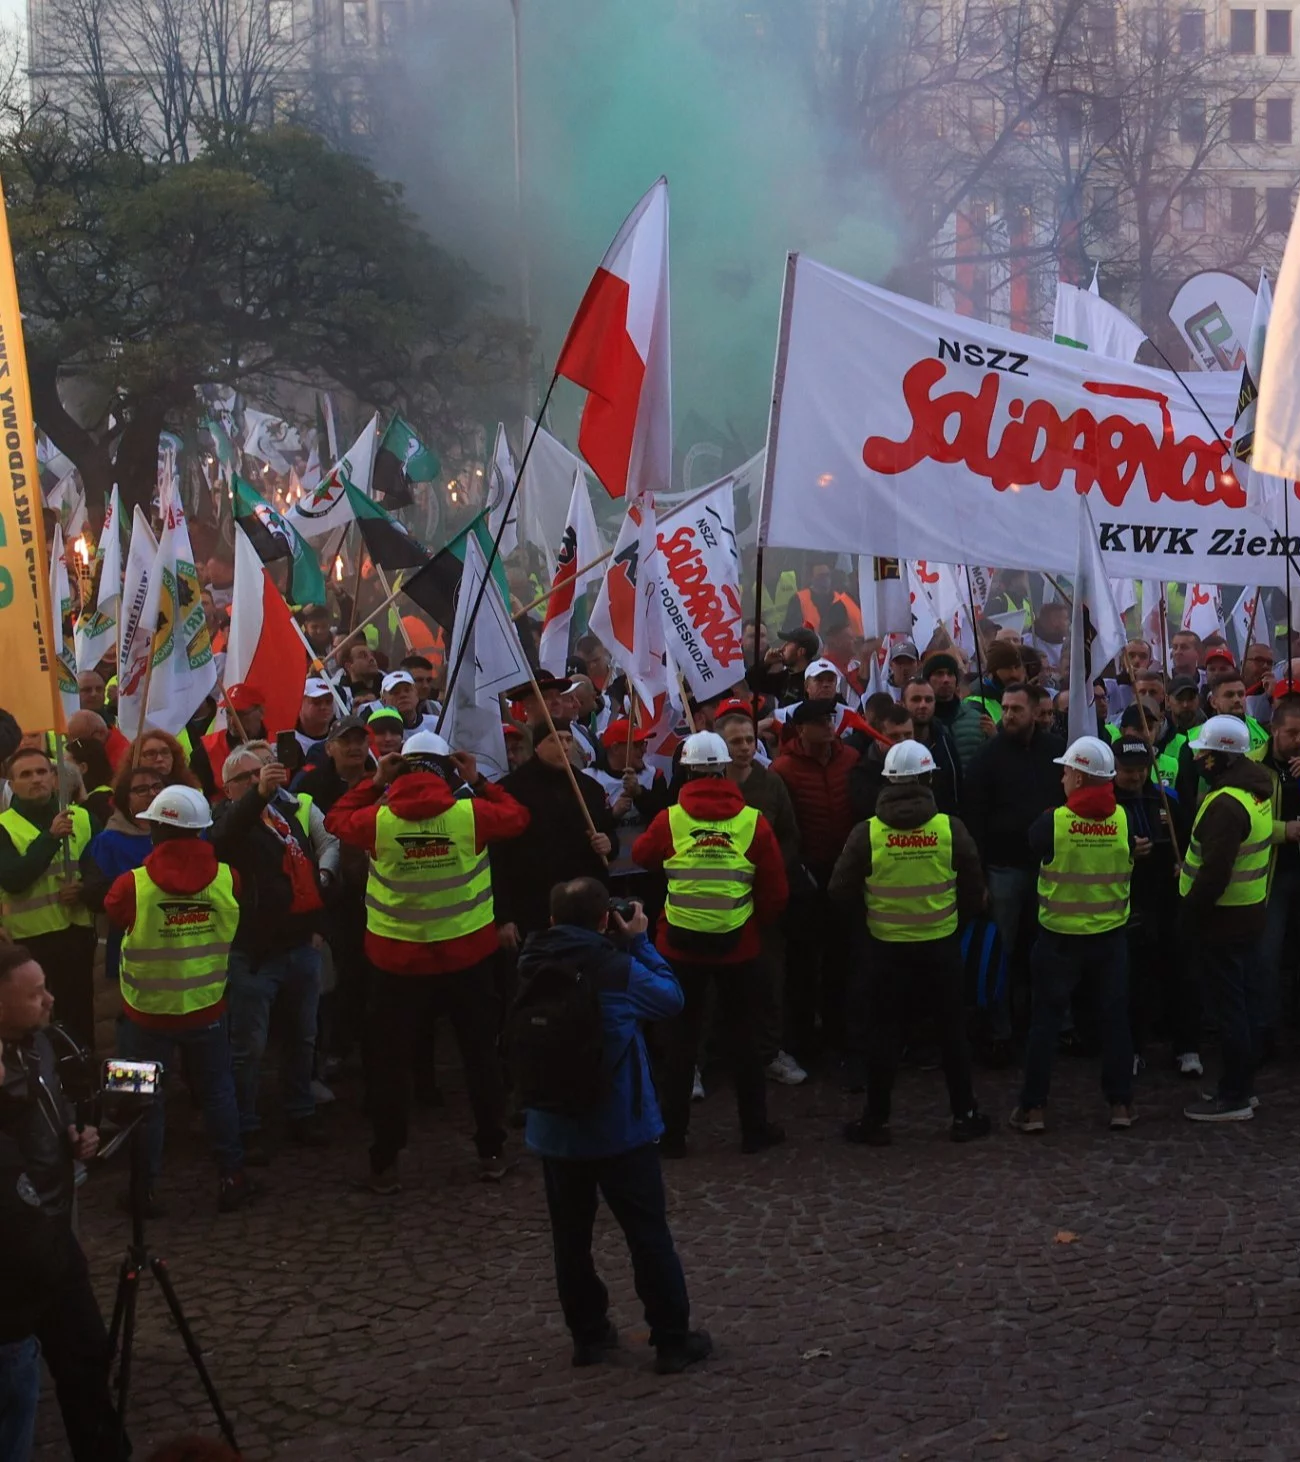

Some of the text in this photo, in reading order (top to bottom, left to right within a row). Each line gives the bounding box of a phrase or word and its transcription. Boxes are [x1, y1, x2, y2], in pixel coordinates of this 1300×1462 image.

[937, 337, 1030, 377] NSZZ
[696, 517, 718, 549] NSZZ
[1100, 522, 1199, 556] KWK
[661, 587, 715, 683] PODBESKIDZIE
